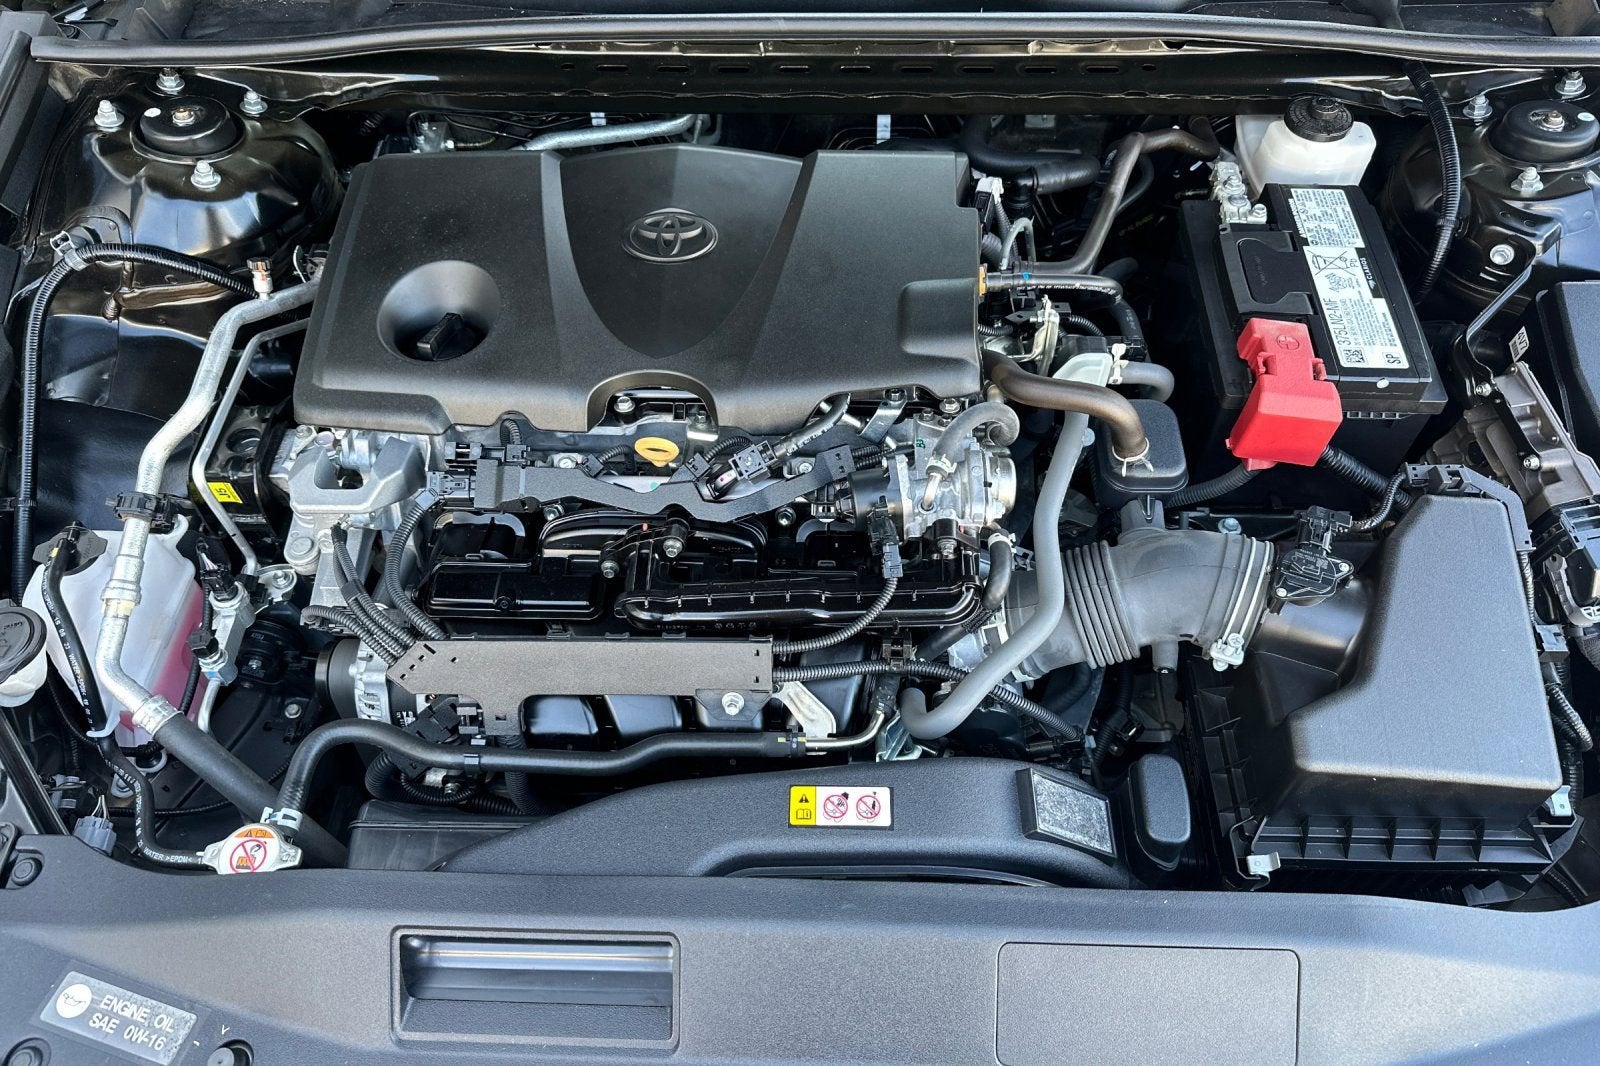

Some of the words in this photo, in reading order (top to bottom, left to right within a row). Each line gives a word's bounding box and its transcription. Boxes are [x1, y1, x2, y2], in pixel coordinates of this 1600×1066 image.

[1360, 257, 1373, 281] CLARIOS
[1323, 298, 1351, 346] 375LN2-MF
[1386, 353, 1402, 365] SP
[68, 653, 81, 676] WATER
[143, 846, 165, 861] WATER
[100, 994, 150, 1023] ENGINE
[154, 1014, 174, 1033] OIL
[89, 1012, 120, 1034] SAE
[123, 1025, 167, 1051] 0W-16
